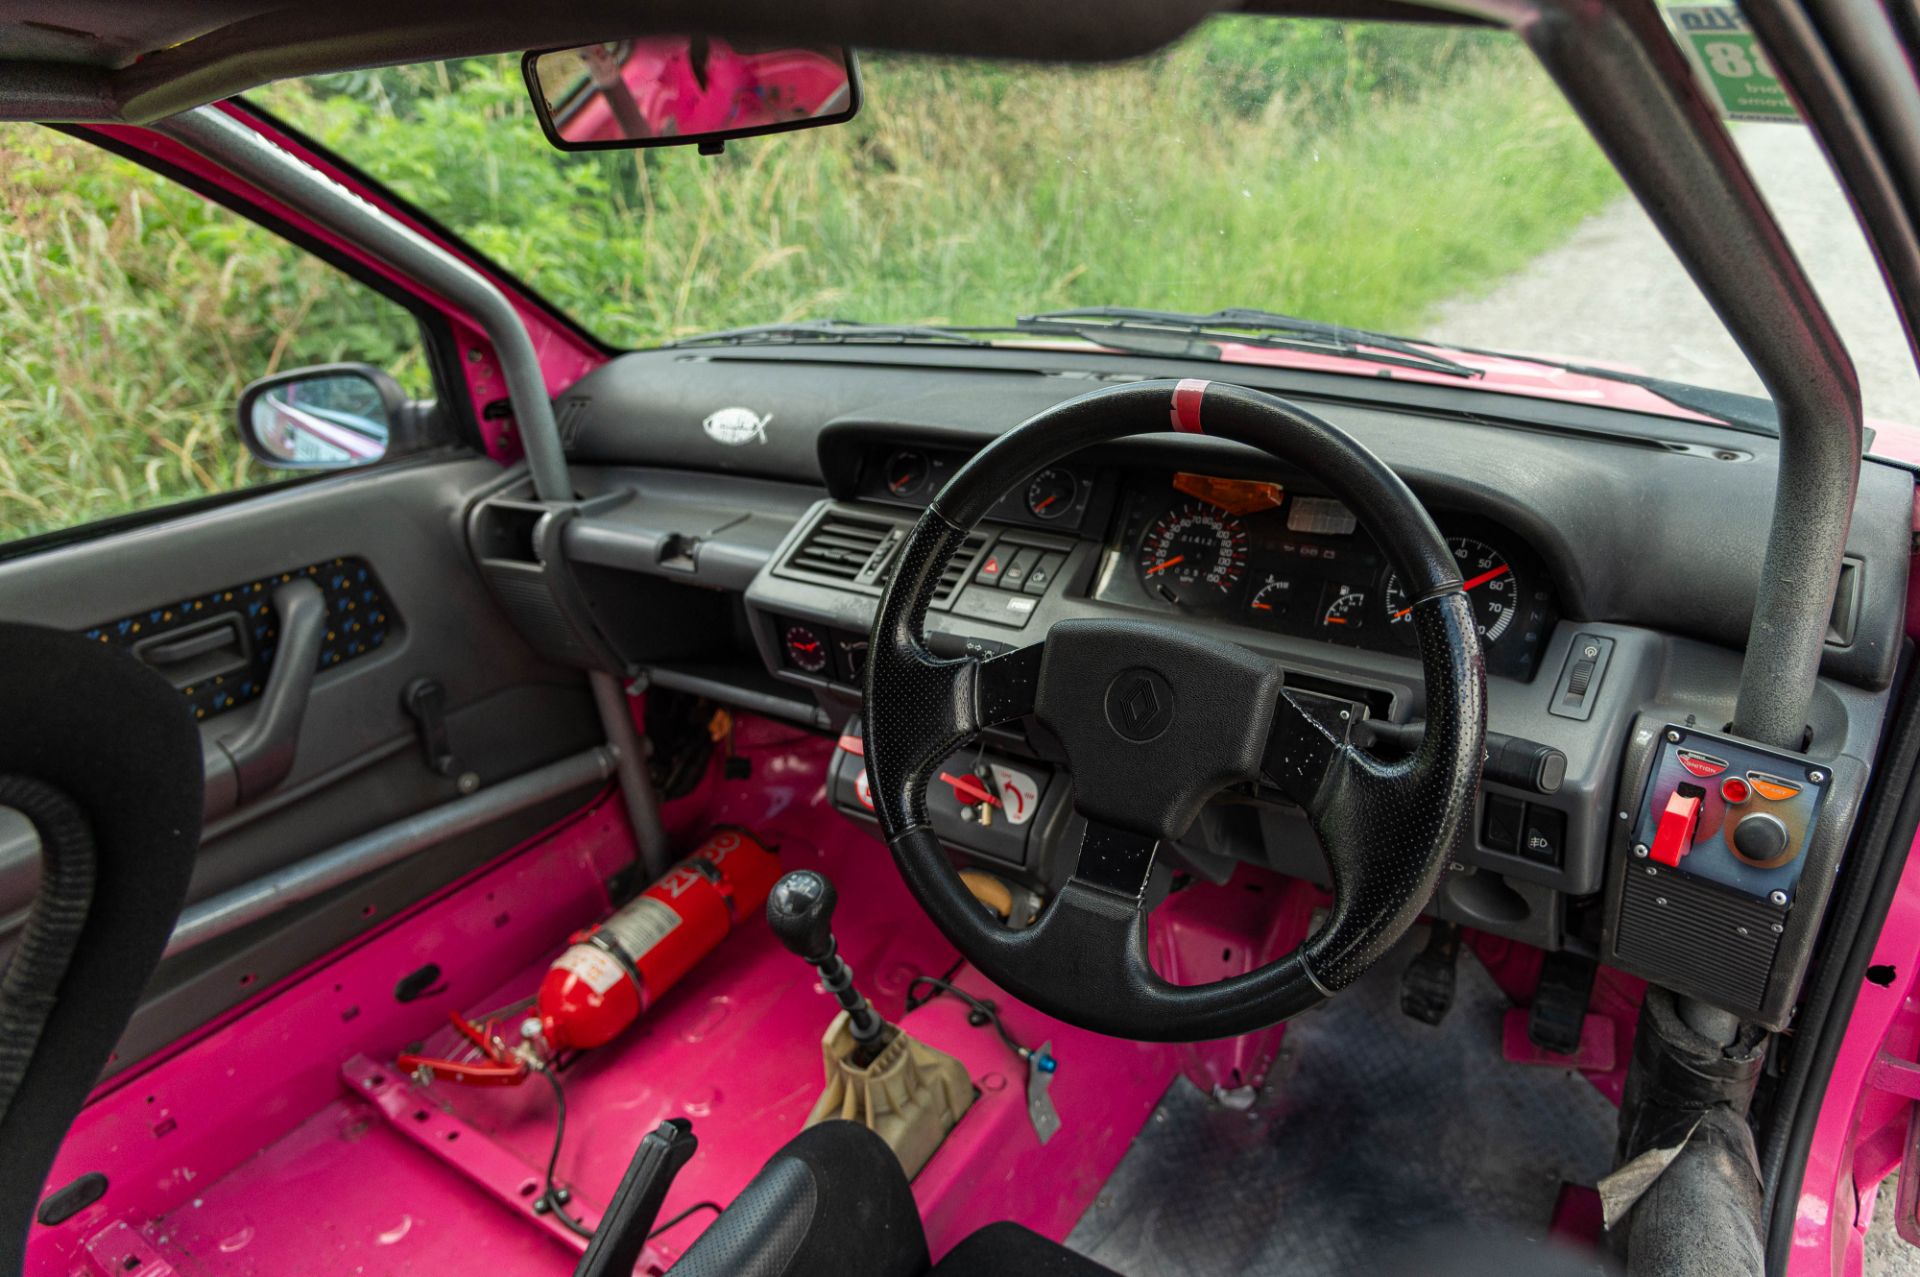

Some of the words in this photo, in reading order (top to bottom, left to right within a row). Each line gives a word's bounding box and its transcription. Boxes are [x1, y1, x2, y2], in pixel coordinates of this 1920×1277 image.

[1216, 530, 1230, 539] 100
[1219, 549, 1233, 557] 120
[1454, 549, 1468, 559] 40
[1478, 559, 1492, 569] 50
[1489, 580, 1504, 591] 60
[1488, 602, 1503, 613] 70
[1404, 613, 1412, 623] 0
